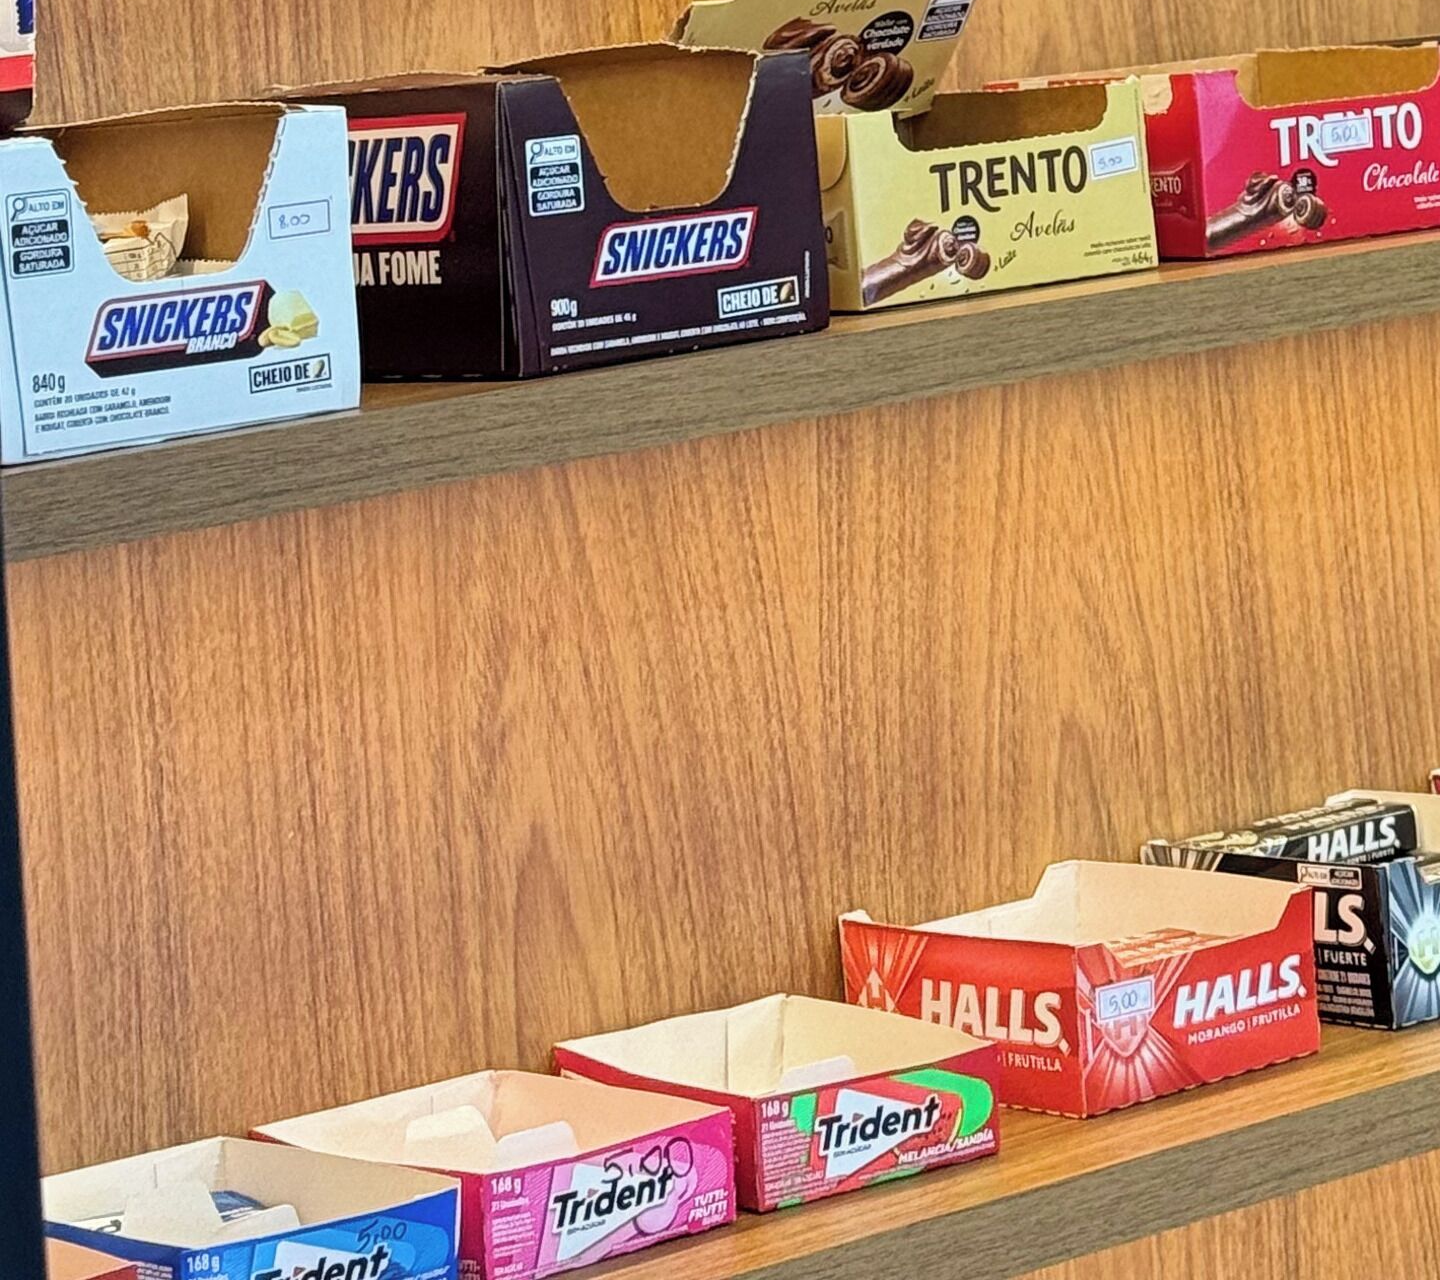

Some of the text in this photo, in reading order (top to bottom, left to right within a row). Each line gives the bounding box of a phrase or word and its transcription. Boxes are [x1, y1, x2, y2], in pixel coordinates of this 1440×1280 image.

[1270, 102, 1422, 167] TRTO
[929, 145, 1088, 213] TRENTO
[1363, 160, 1440, 191] Chocolate
[602, 215, 748, 276] SNICKERS
[379, 250, 442, 286] FOME
[550, 298, 570, 317] 900
[722, 284, 779, 313] CHEIO DE
[97, 291, 254, 351] SNICKERS
[185, 331, 239, 355] BRANCO
[32, 373, 65, 394] 840 g
[254, 366, 291, 388] CHEIO
[294, 362, 310, 380] DE
[1323, 948, 1368, 967] FUERTE
[1187, 1003, 1300, 1045] MORANGO FRUTILLA
[1008, 1053, 1063, 1073] FRUTILLA
[761, 1099, 781, 1118] 168
[818, 1095, 940, 1151] Trident
[491, 1176, 513, 1195] 168
[552, 1167, 673, 1229] Trident
[688, 1200, 728, 1223] FRUTTI
[356, 1218, 408, 1252] 5,00
[187, 1253, 209, 1273] 168
[211, 1256, 220, 1273] g
